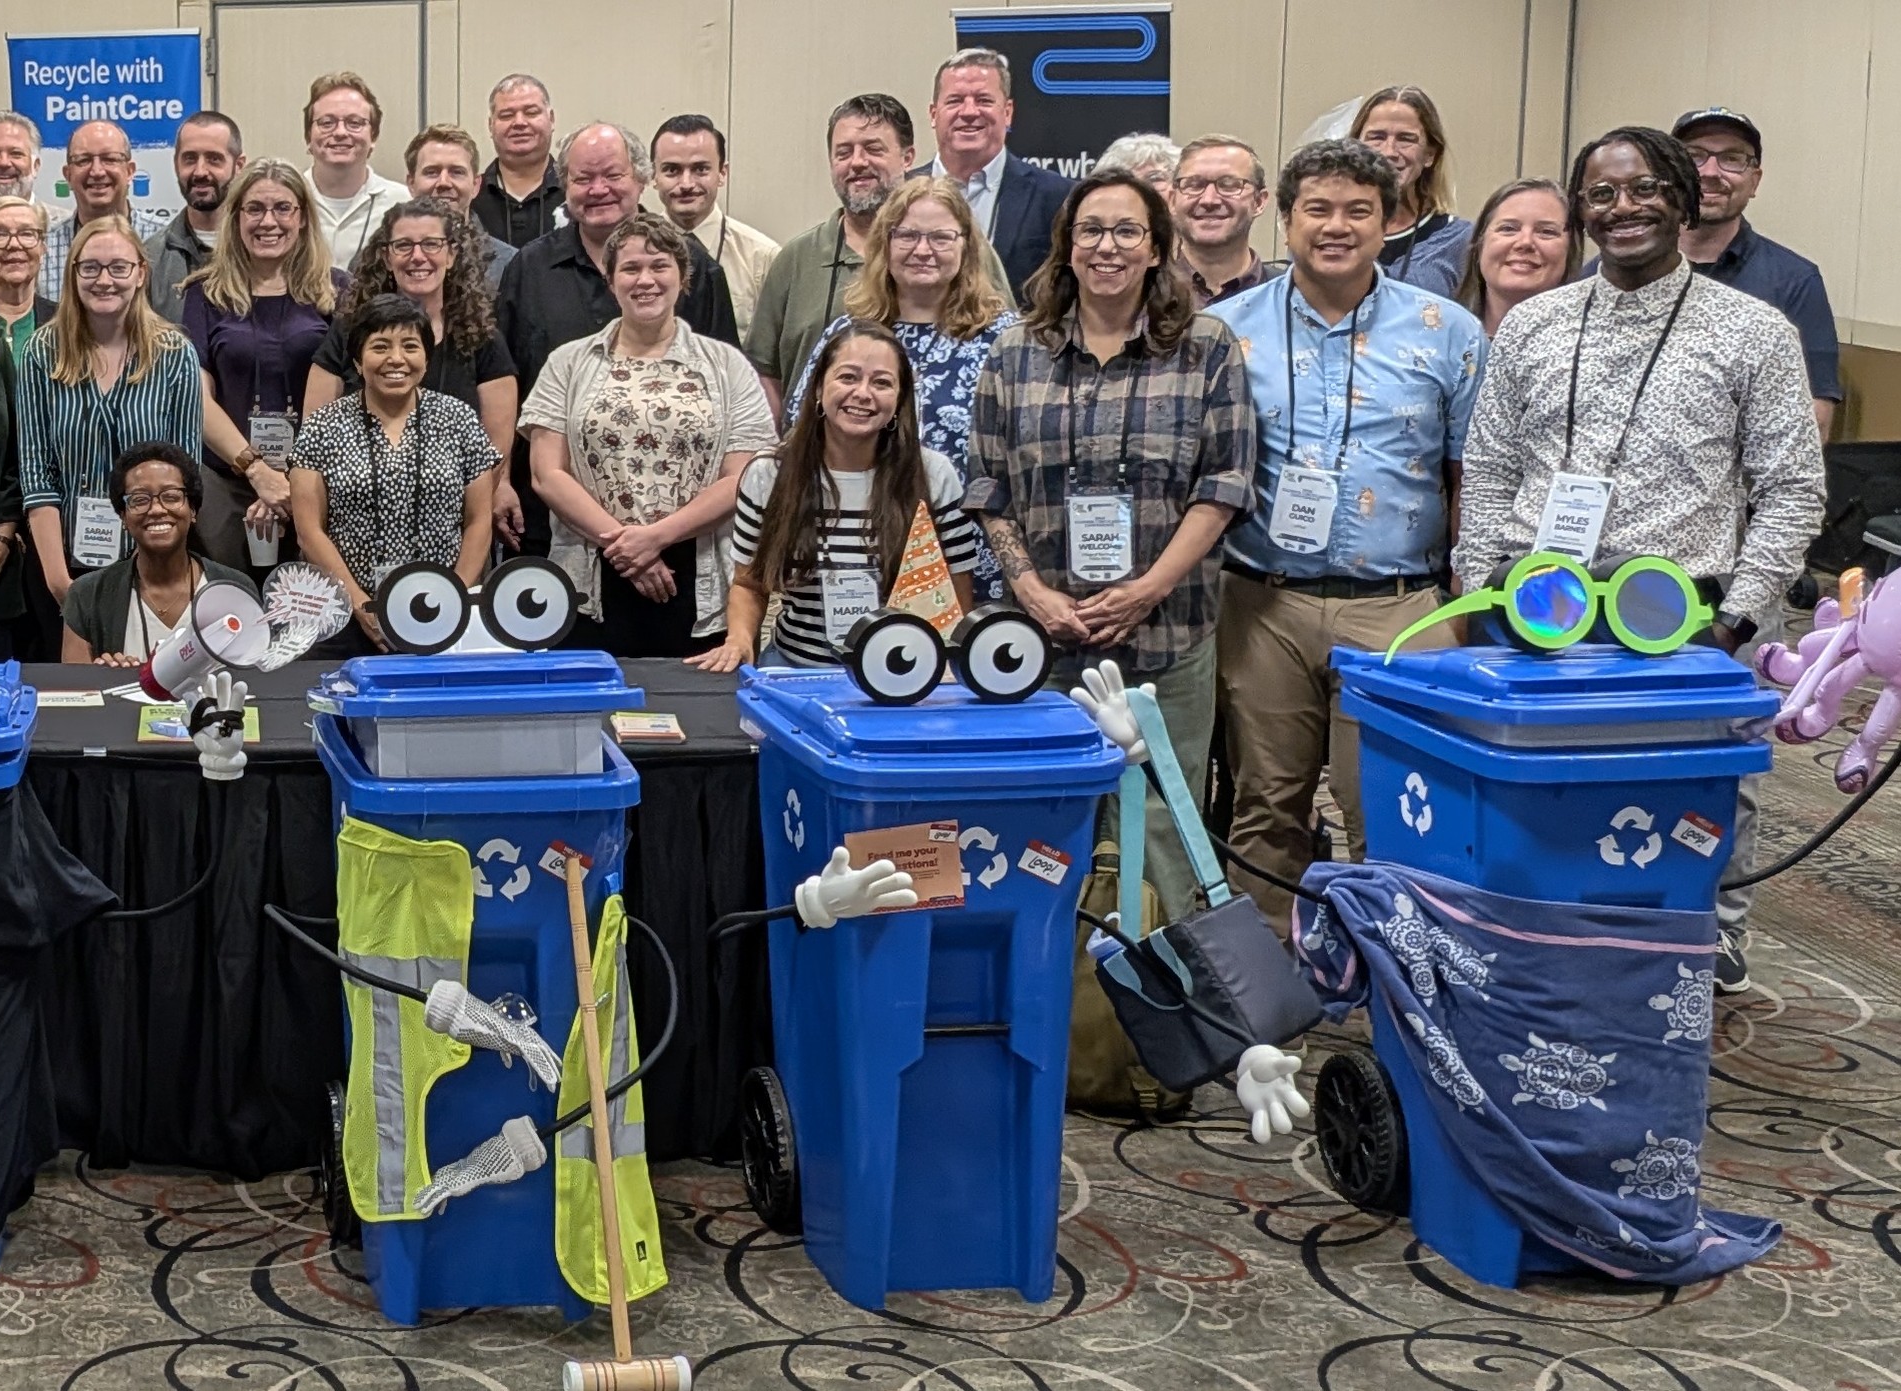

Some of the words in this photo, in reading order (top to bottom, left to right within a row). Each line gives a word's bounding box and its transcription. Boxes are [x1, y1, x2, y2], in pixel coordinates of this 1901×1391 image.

[24, 58, 110, 91] Recycle
[116, 56, 164, 84] with
[45, 94, 184, 121] PaintCare
[258, 443, 284, 451] CLAIR
[1291, 503, 1316, 515] DAN
[1555, 513, 1590, 526] MYLES
[84, 527, 113, 536] SARAH
[1554, 523, 1587, 534] BARNES
[1081, 533, 1120, 542] SARAH
[832, 605, 872, 616] MARIA
[895, 849, 913, 858] me
[913, 846, 940, 858] your
[1027, 855, 1060, 876] Loop!
